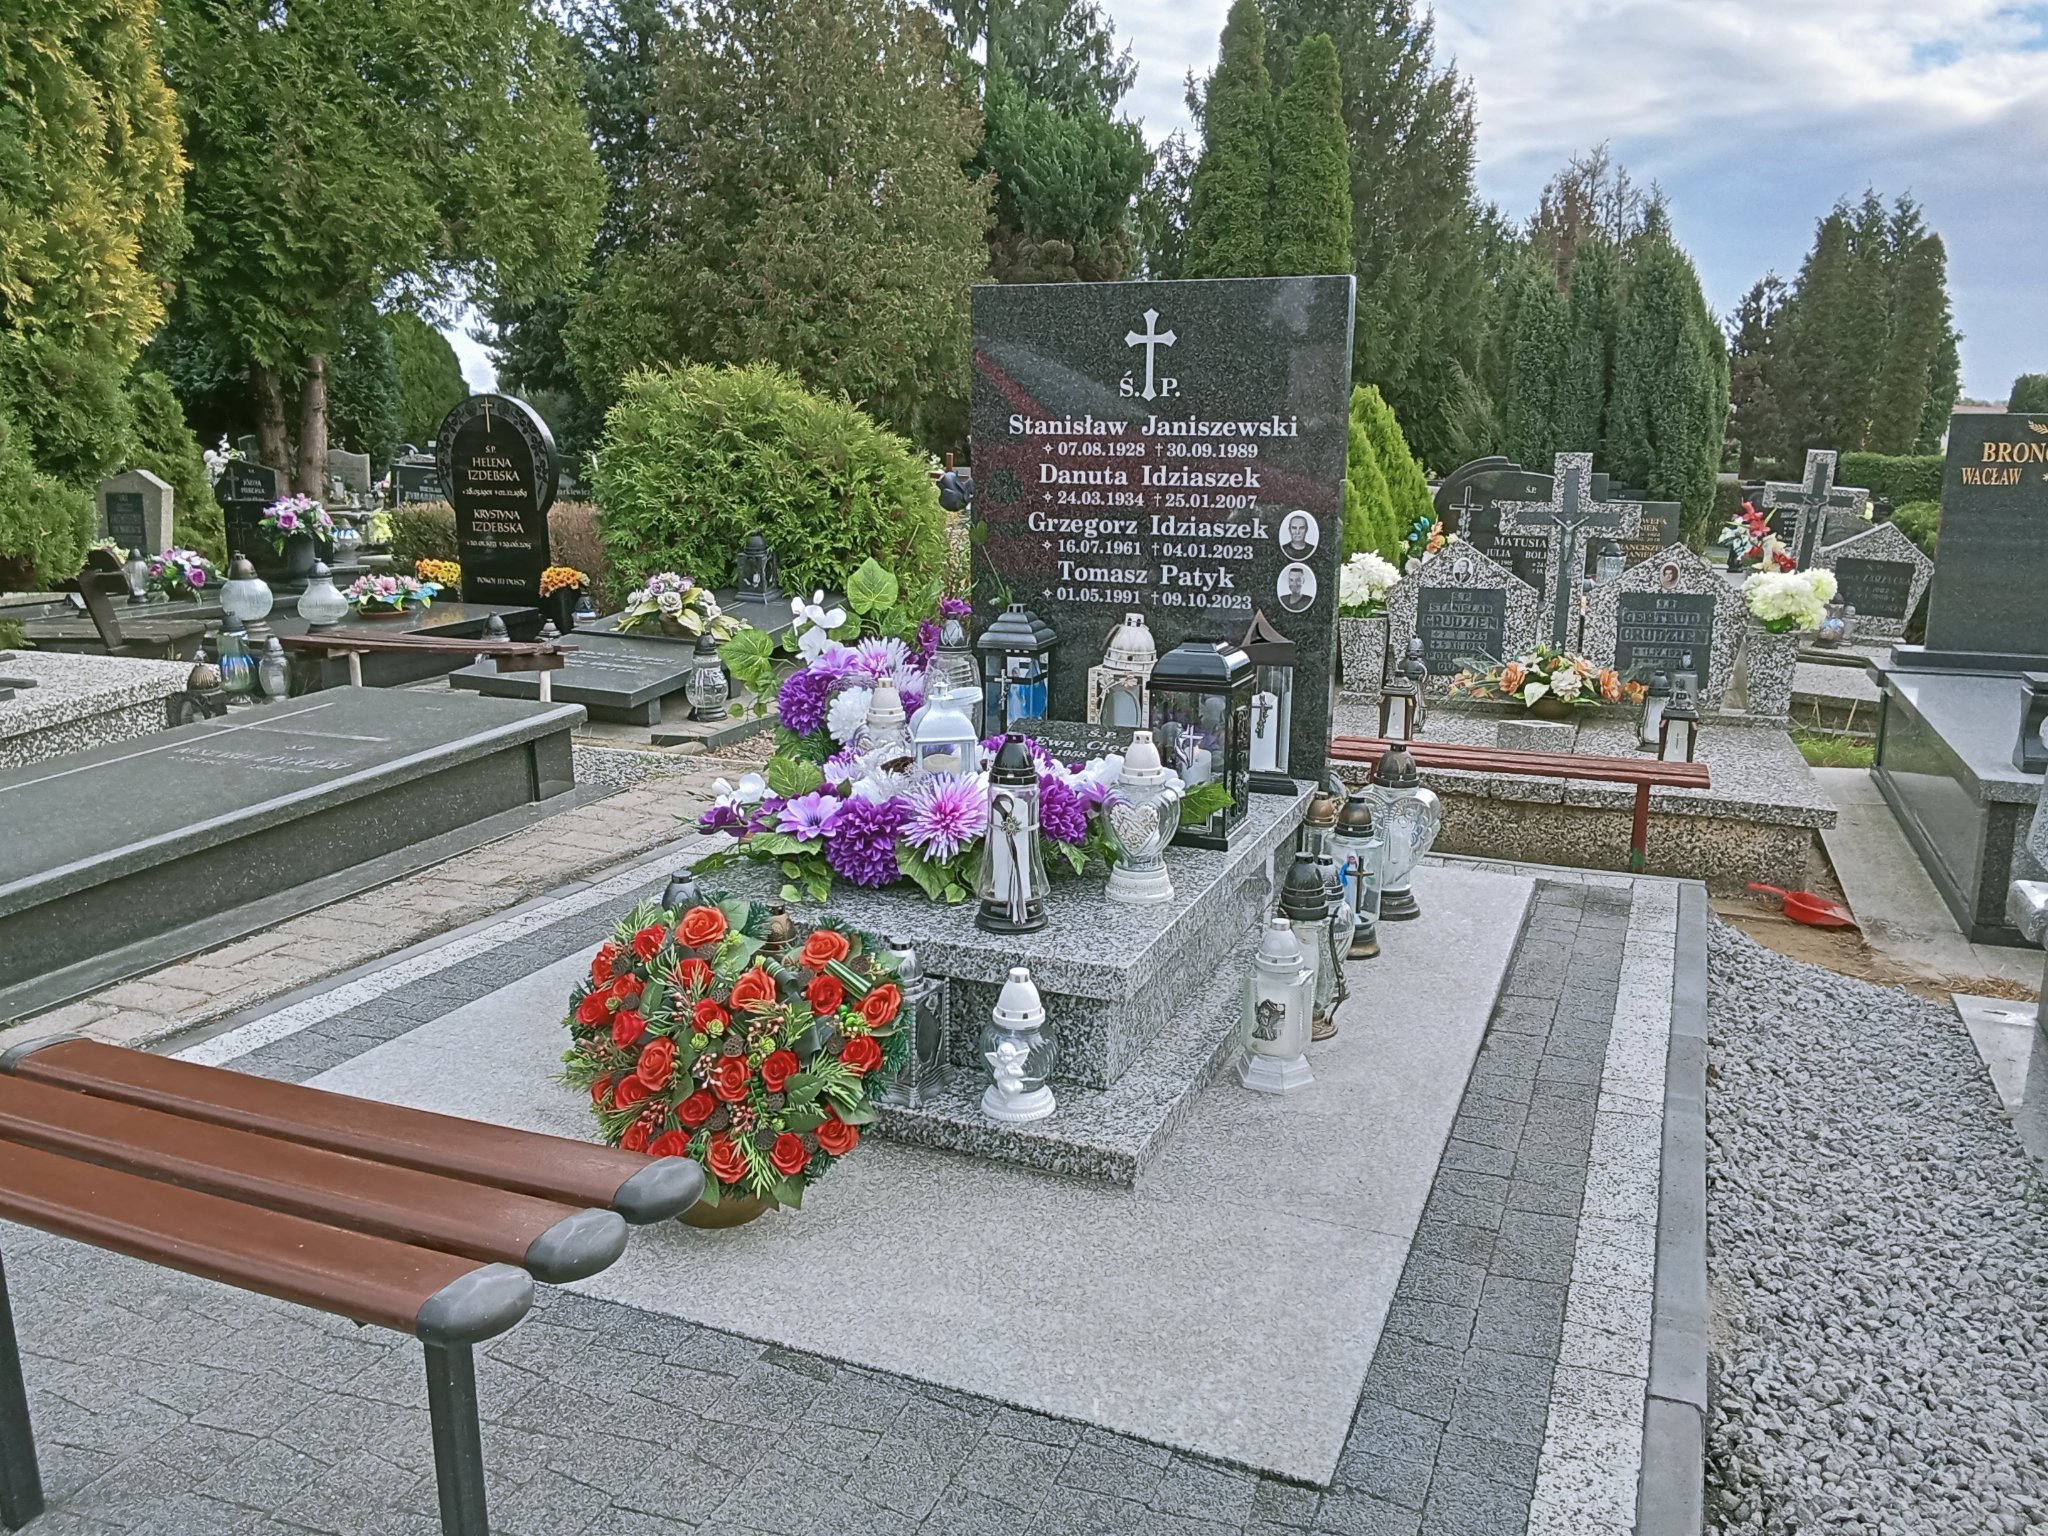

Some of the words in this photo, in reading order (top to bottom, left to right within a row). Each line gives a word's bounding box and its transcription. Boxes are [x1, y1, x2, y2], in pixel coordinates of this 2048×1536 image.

[1119, 370, 1140, 398] Ś.
[1160, 377, 1181, 397] P.
[1009, 414, 1128, 436] Stanisław
[1141, 415, 1298, 437] Janiszewski
[1058, 441, 1146, 457] 07.08.1928
[1166, 442, 1259, 459] 30.09.1989
[1981, 442, 2048, 463] BRON
[472, 457, 512, 468] HELENA
[468, 469, 520, 482] IZDEBSKA
[1039, 463, 1129, 485] Danuta
[1141, 465, 1261, 488] Idziaszek
[1961, 467, 2022, 485] WACŁAW
[1057, 491, 1143, 507] 24.03.1934
[1165, 493, 1258, 509] 25.01.2007
[473, 509, 521, 520] KRYSTYNA
[472, 521, 525, 533] IZDEBSKA
[1028, 511, 1138, 538] Grzegorz
[1150, 515, 1269, 539] Idziaszek
[1058, 540, 1142, 555] 16.07.1961
[1163, 543, 1254, 560] 04.01.2023
[1494, 537, 1547, 548] MATUSIA
[1487, 549, 1511, 558] JULIA
[1058, 561, 1148, 584] Tomasz
[1160, 565, 1235, 592] Patyk
[1057, 587, 1141, 604] 01.05.1991
[1162, 592, 1252, 610] 09.10.2023
[1035, 736, 1076, 748] Ewa
